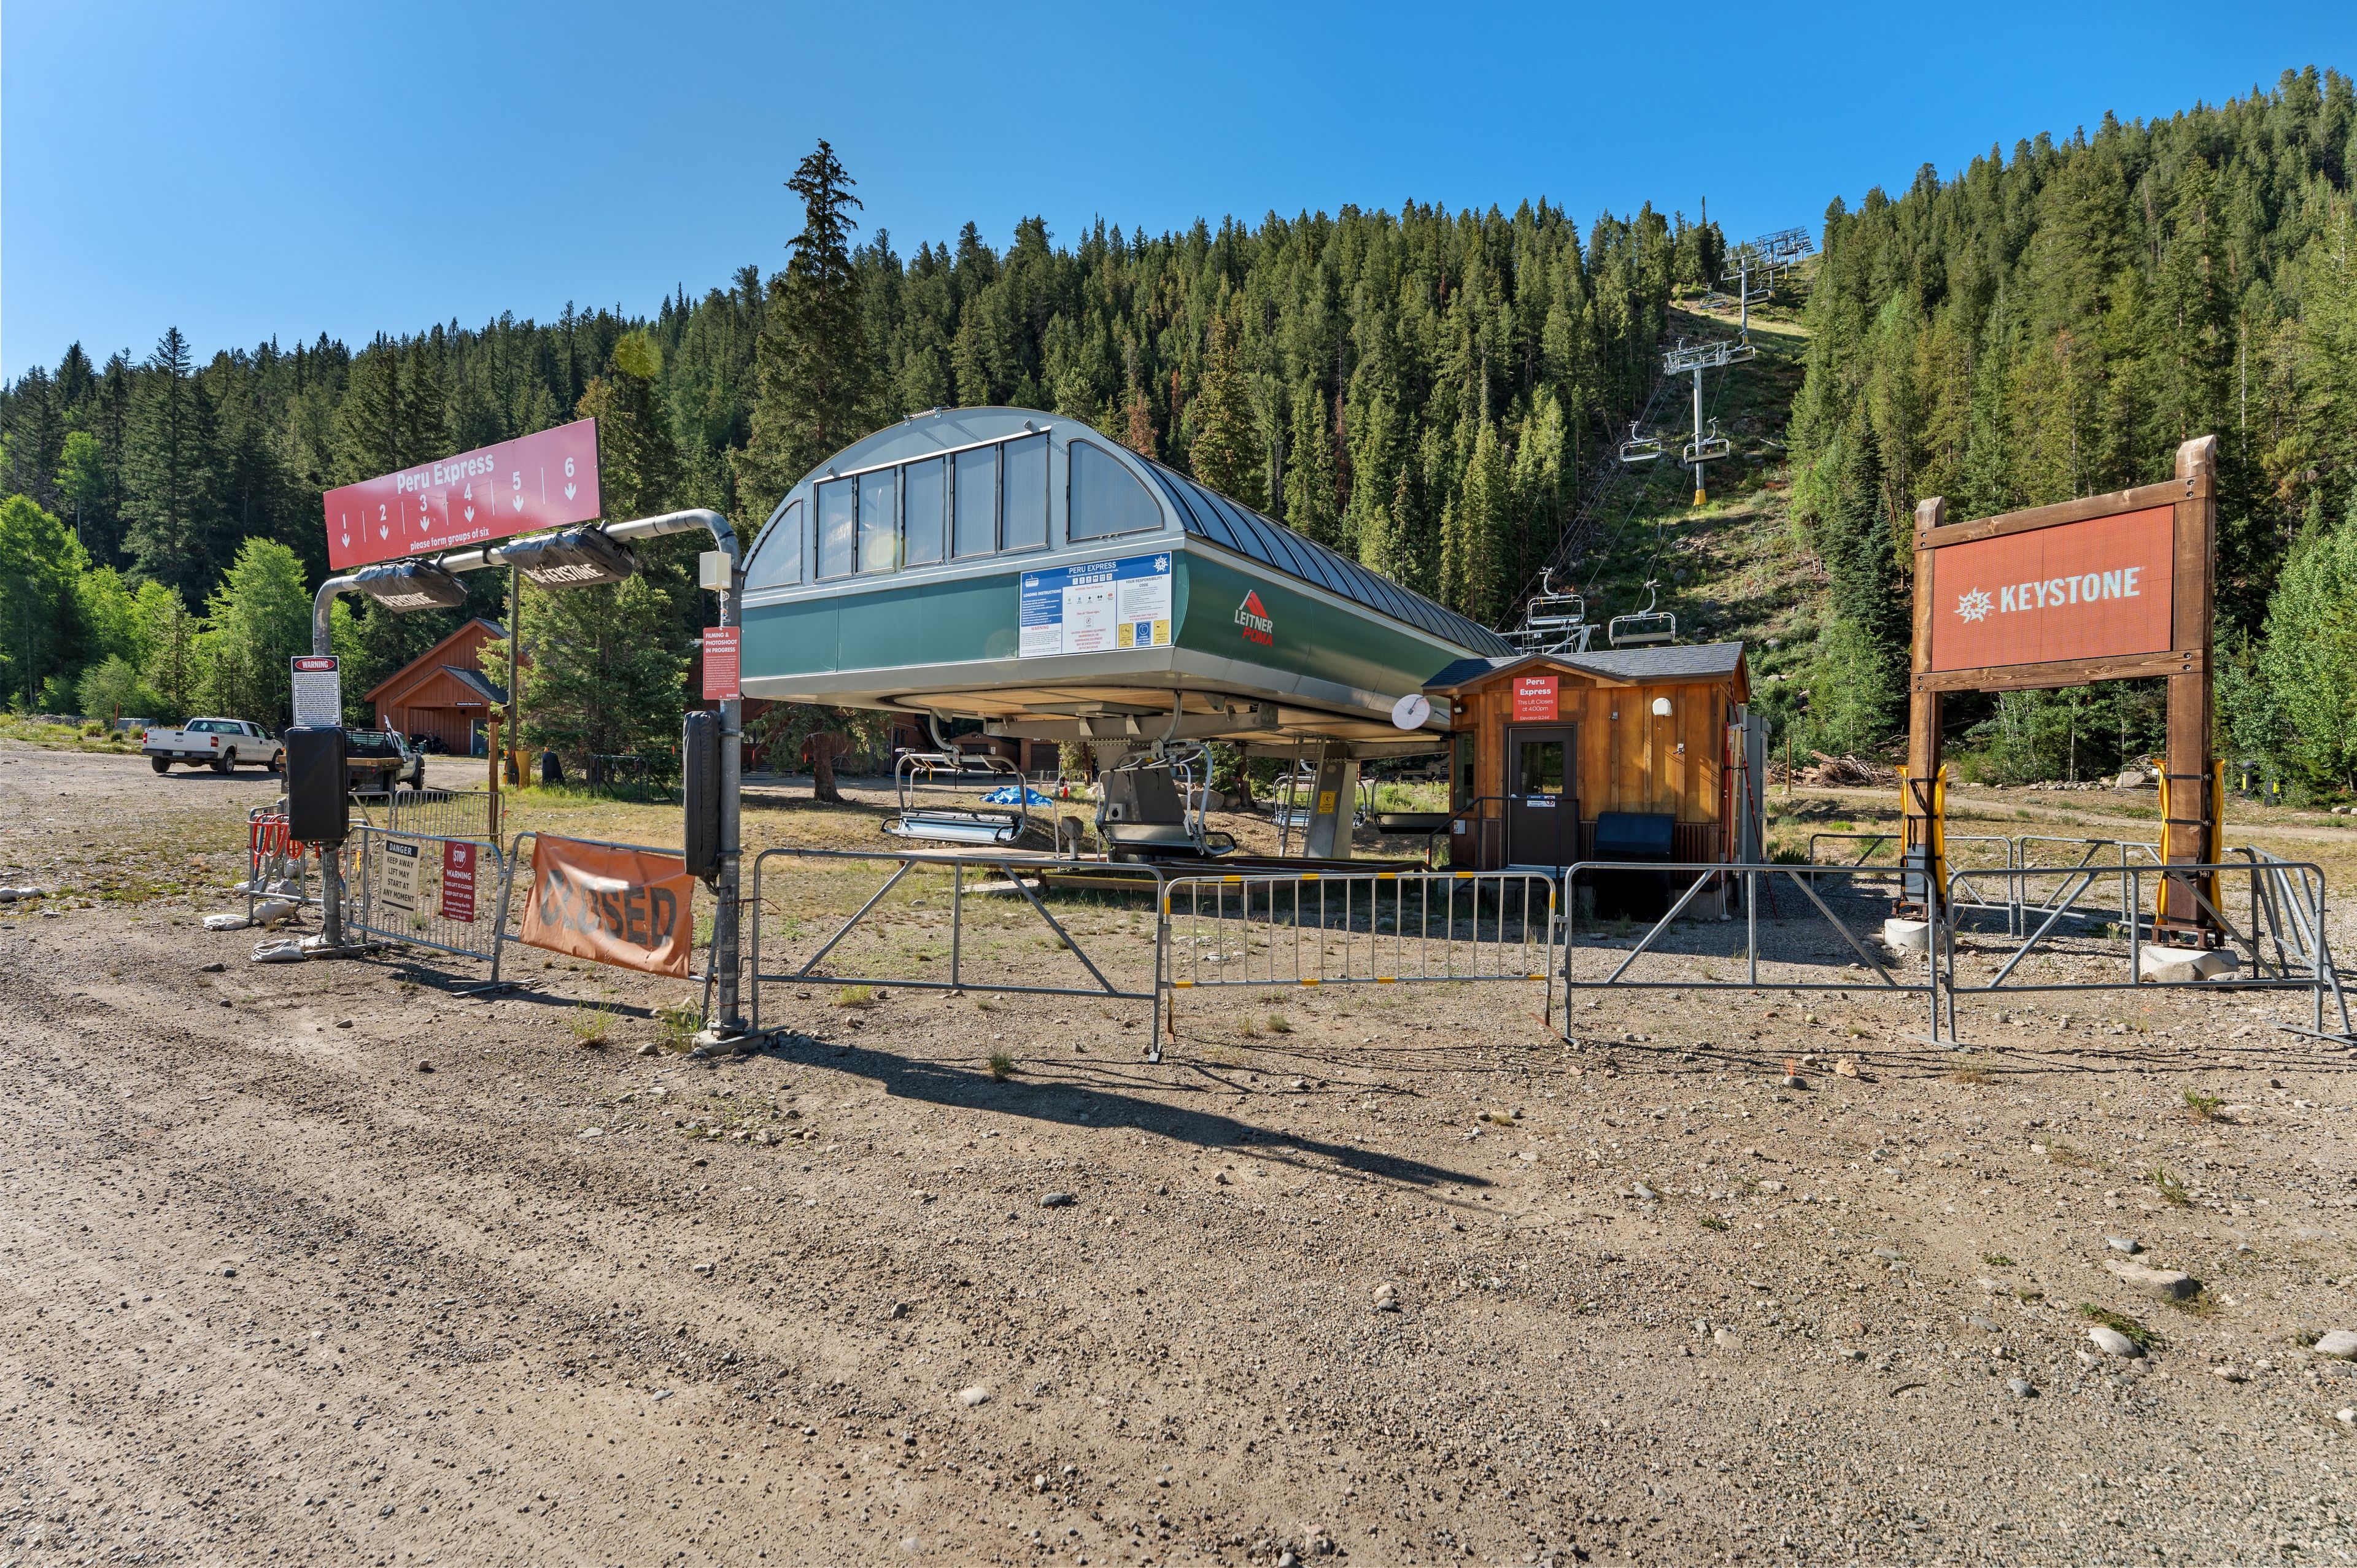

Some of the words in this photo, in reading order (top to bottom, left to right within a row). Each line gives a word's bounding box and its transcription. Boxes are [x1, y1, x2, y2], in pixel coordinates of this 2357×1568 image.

[397, 471, 430, 494] Peru
[434, 454, 494, 486] Express
[342, 513, 346, 529] 1
[379, 504, 387, 521] 2
[420, 494, 427, 512] 3
[464, 483, 473, 500] 4
[513, 471, 521, 490] 5
[565, 457, 575, 477] 6
[410, 540, 430, 552] please
[432, 537, 447, 547] form
[448, 532, 471, 546] groups
[472, 528, 479, 538] of
[479, 527, 489, 537] six
[542, 563, 605, 583] KEYSTONE
[1069, 565, 1086, 574] PERU
[1087, 562, 1117, 572] EXPRESS
[2000, 566, 2146, 614] KEYSTONE
[1234, 609, 1273, 634] LEITNER
[1242, 626, 1273, 647] POMA
[389, 843, 412, 855] DANGER
[454, 850, 465, 863] STOP
[387, 855, 398, 865] KEEP
[399, 859, 414, 868] AWAY
[389, 867, 398, 876] LIFT
[399, 870, 409, 879] MAY
[446, 869, 471, 881] WARNING
[387, 878, 402, 888] START
[383, 888, 392, 897] ANY
[393, 891, 414, 903] MOMENT
